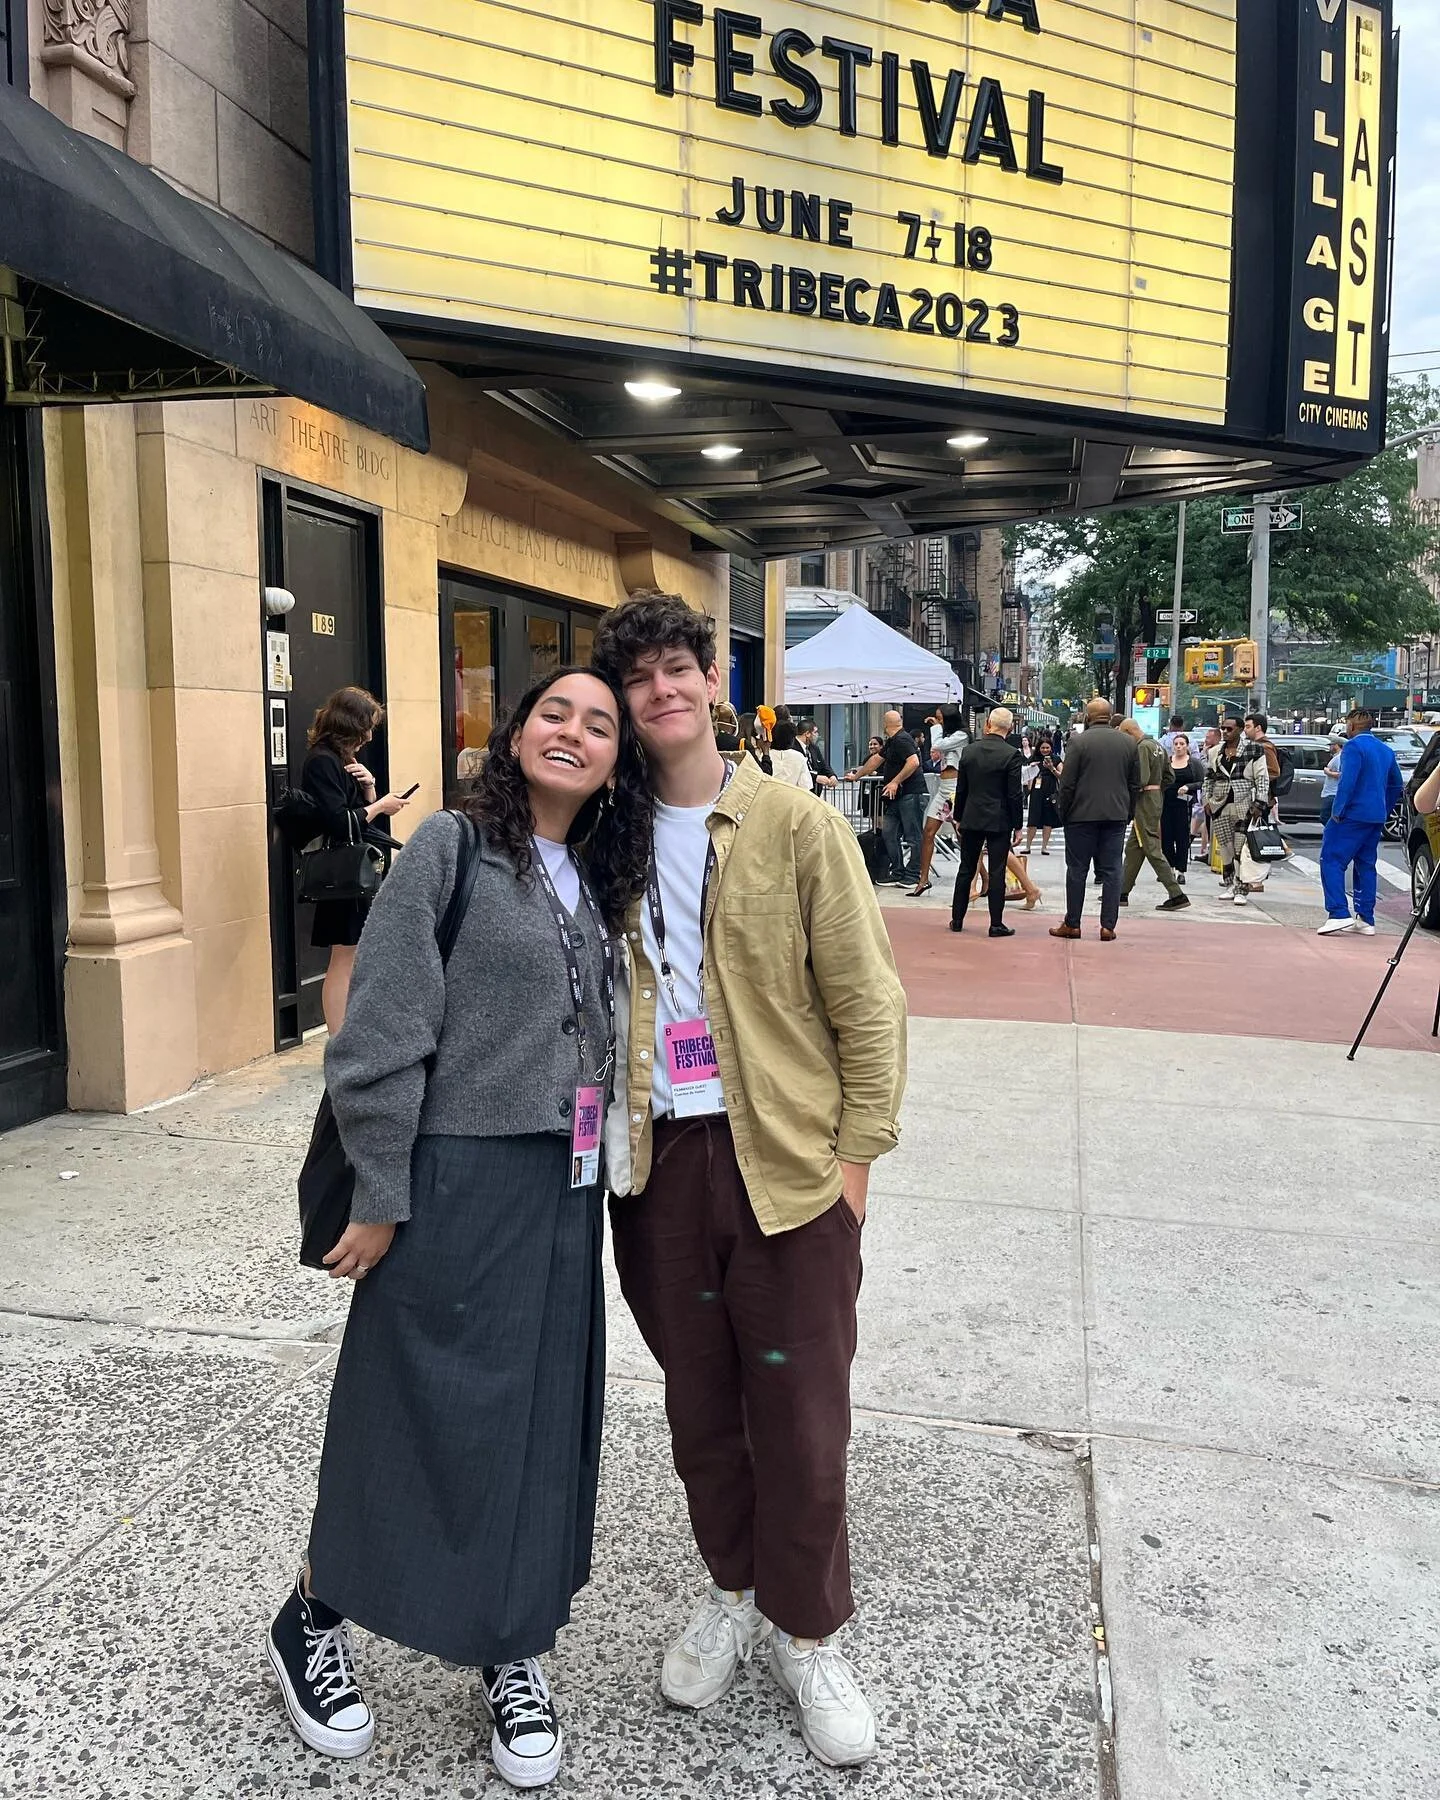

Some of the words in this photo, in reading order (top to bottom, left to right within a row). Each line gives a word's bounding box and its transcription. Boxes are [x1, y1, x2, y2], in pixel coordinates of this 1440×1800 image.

[654, 0, 1064, 186] FESTIVAL
[715, 176, 853, 248] JUNE
[898, 210, 993, 272] 7-18
[1303, 0, 1342, 395] VILLAGE
[1347, 15, 1374, 386] EAST
[650, 246, 1020, 347] #TRIBECA2023
[250, 402, 280, 436] ART
[288, 415, 350, 465] THEATRE
[356, 444, 390, 481] BLDG
[1298, 402, 1322, 426] CITY
[1325, 405, 1369, 432] CINEMAS
[1233, 514, 1255, 525] ONE
[517, 523, 548, 562] EAST
[555, 536, 610, 582] CINEMAS
[315, 614, 334, 634] 189
[1146, 650, 1151, 658] E
[665, 1027, 672, 1036] B
[672, 1035, 716, 1055] TRIBECA
